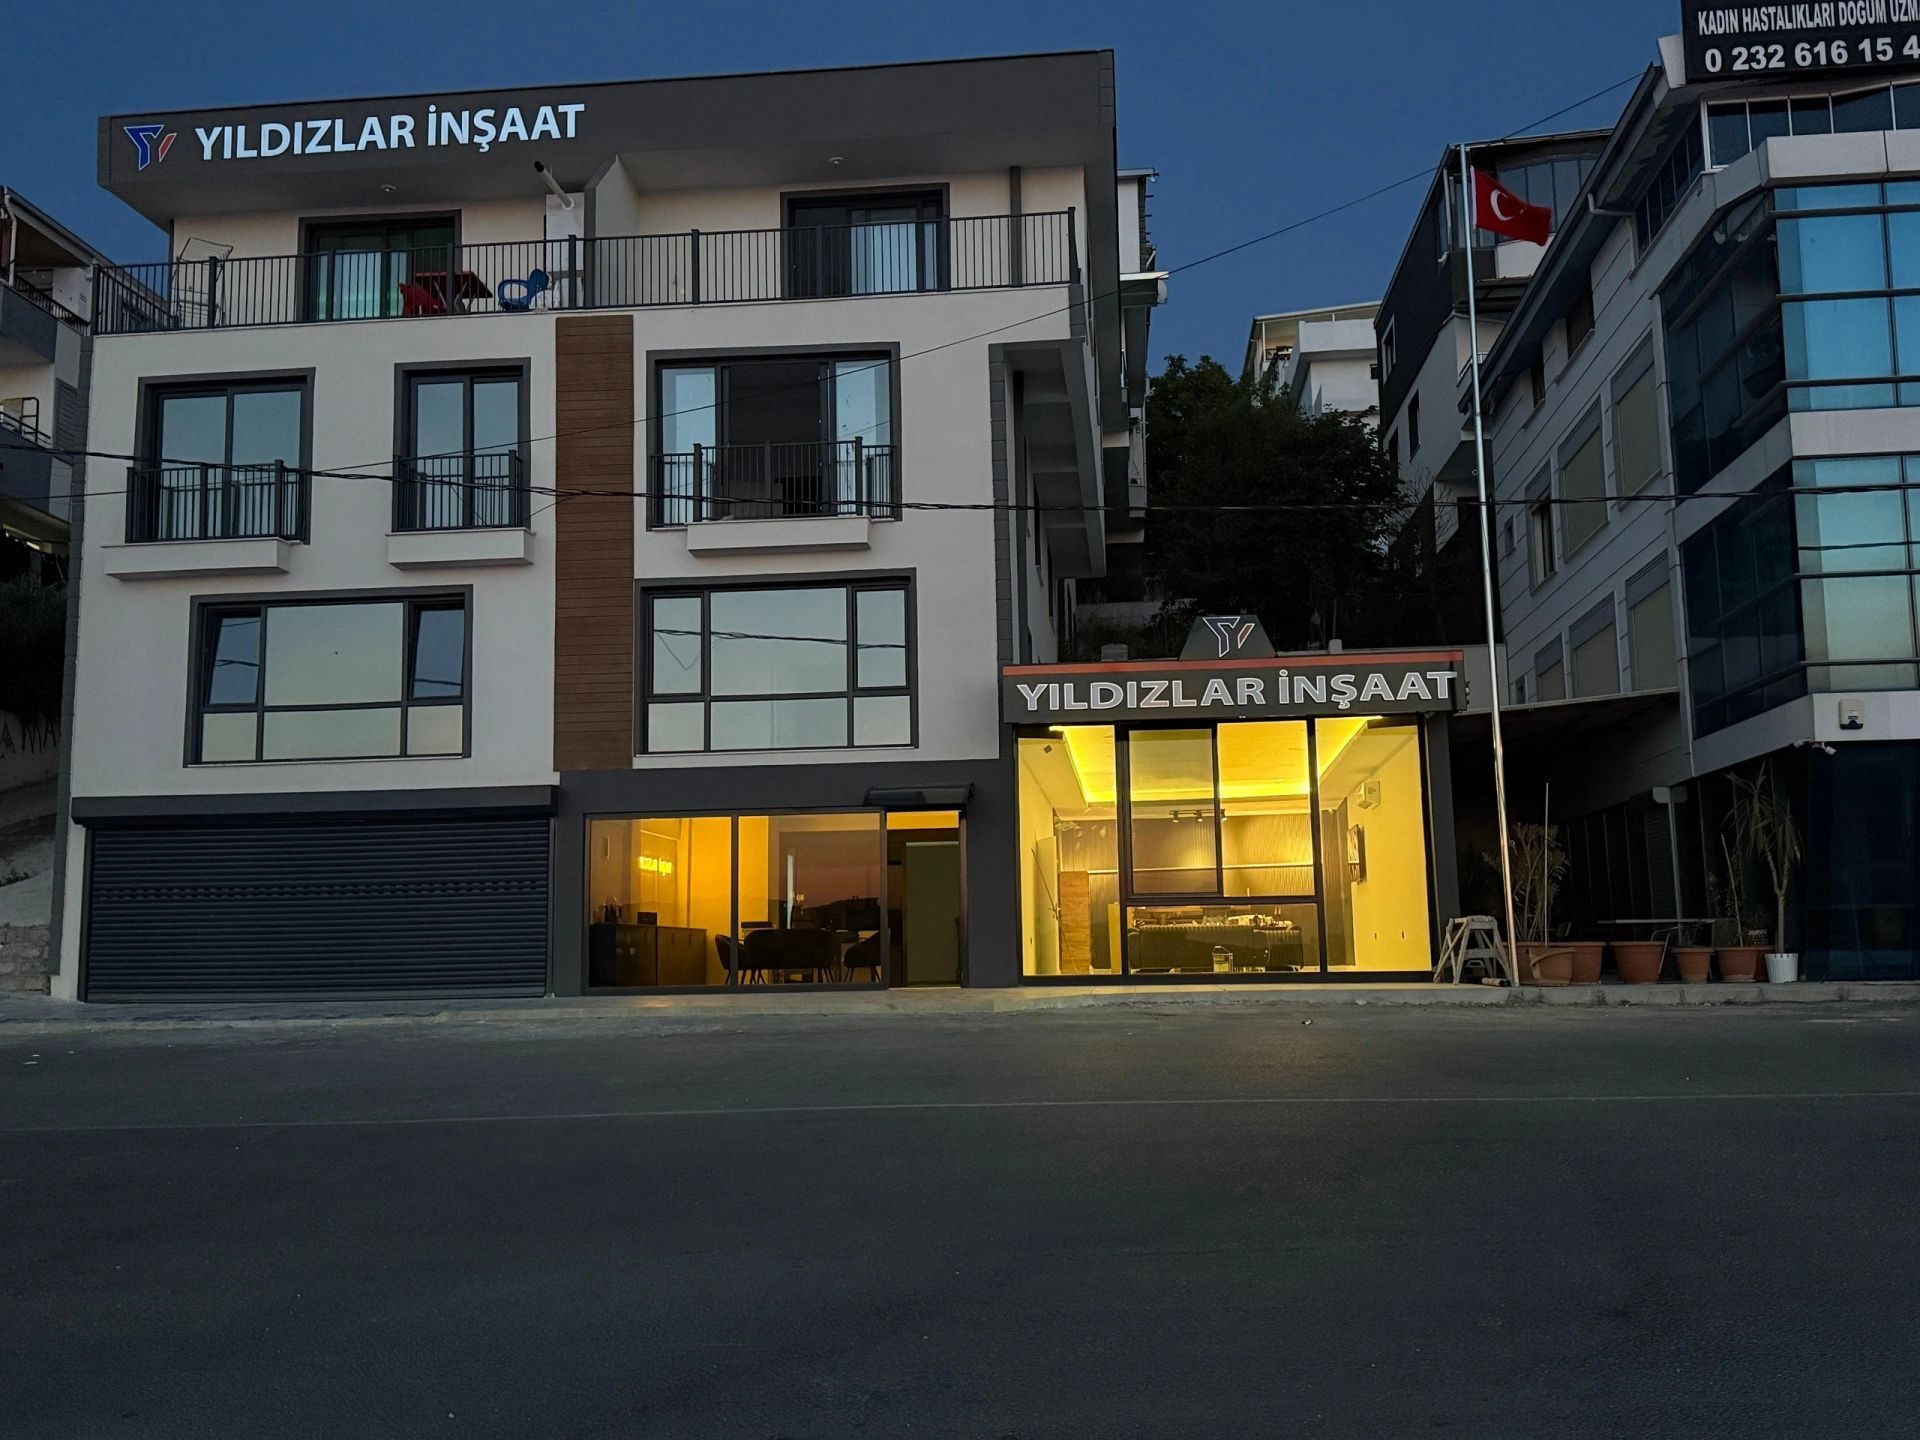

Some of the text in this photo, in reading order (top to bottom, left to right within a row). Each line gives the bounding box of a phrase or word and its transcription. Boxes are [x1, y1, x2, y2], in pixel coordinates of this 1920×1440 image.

[1697, 9, 1739, 36] KADIN
[1742, 3, 1836, 33] HASTALIKLARI
[1705, 49, 1722, 73] 0
[1731, 45, 1786, 71] 232
[1794, 40, 1849, 67] 616
[1858, 37, 1894, 62] 15
[195, 104, 585, 160] YILDIZLAR İNŞAAT
[1016, 669, 1458, 711] YILDIZLAR İNŞAAT
